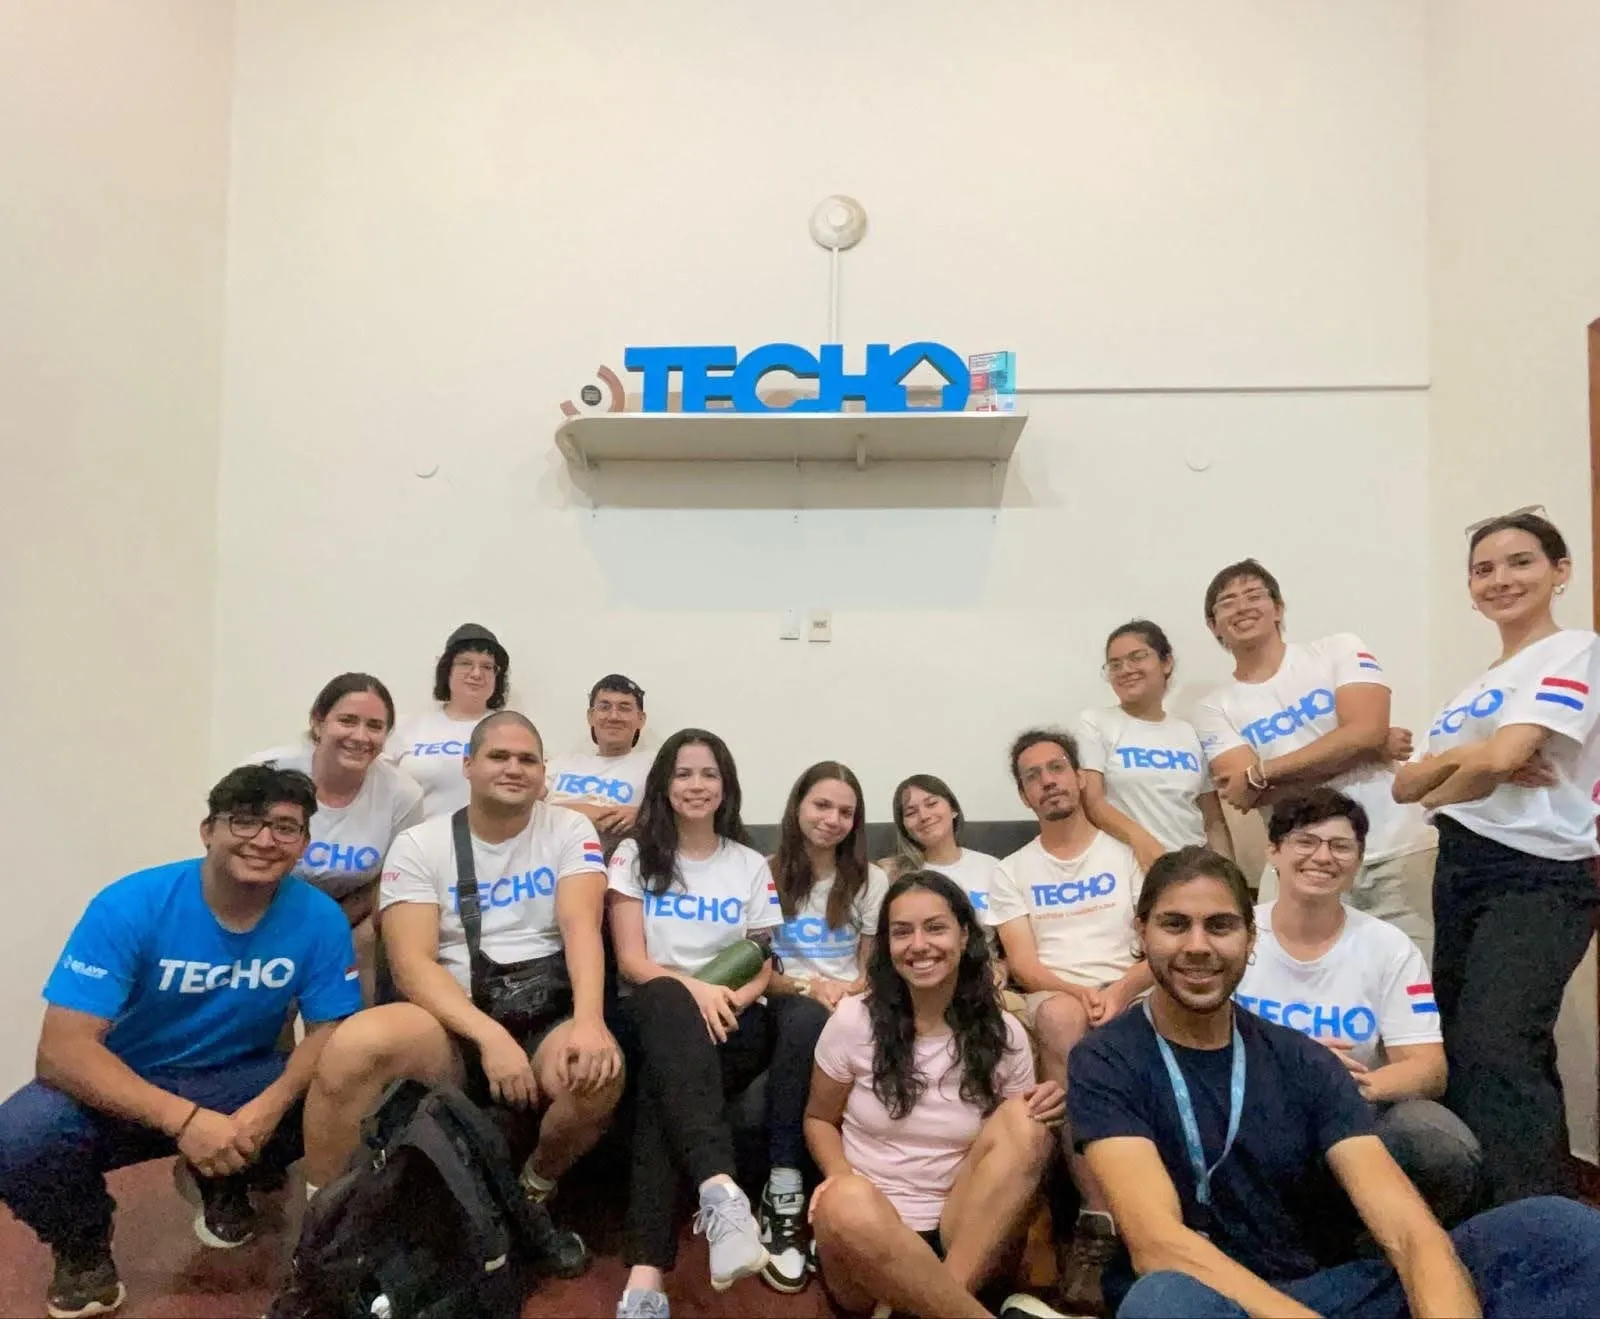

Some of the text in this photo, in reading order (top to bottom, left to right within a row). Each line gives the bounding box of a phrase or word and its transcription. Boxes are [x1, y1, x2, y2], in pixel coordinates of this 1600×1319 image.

[624, 341, 971, 412] TECHO
[1241, 689, 1335, 748] TECHO
[1116, 747, 1199, 772] TECHO
[556, 774, 634, 803] TECHO
[1031, 872, 1116, 907] TECHO
[158, 957, 295, 993] TECHO
